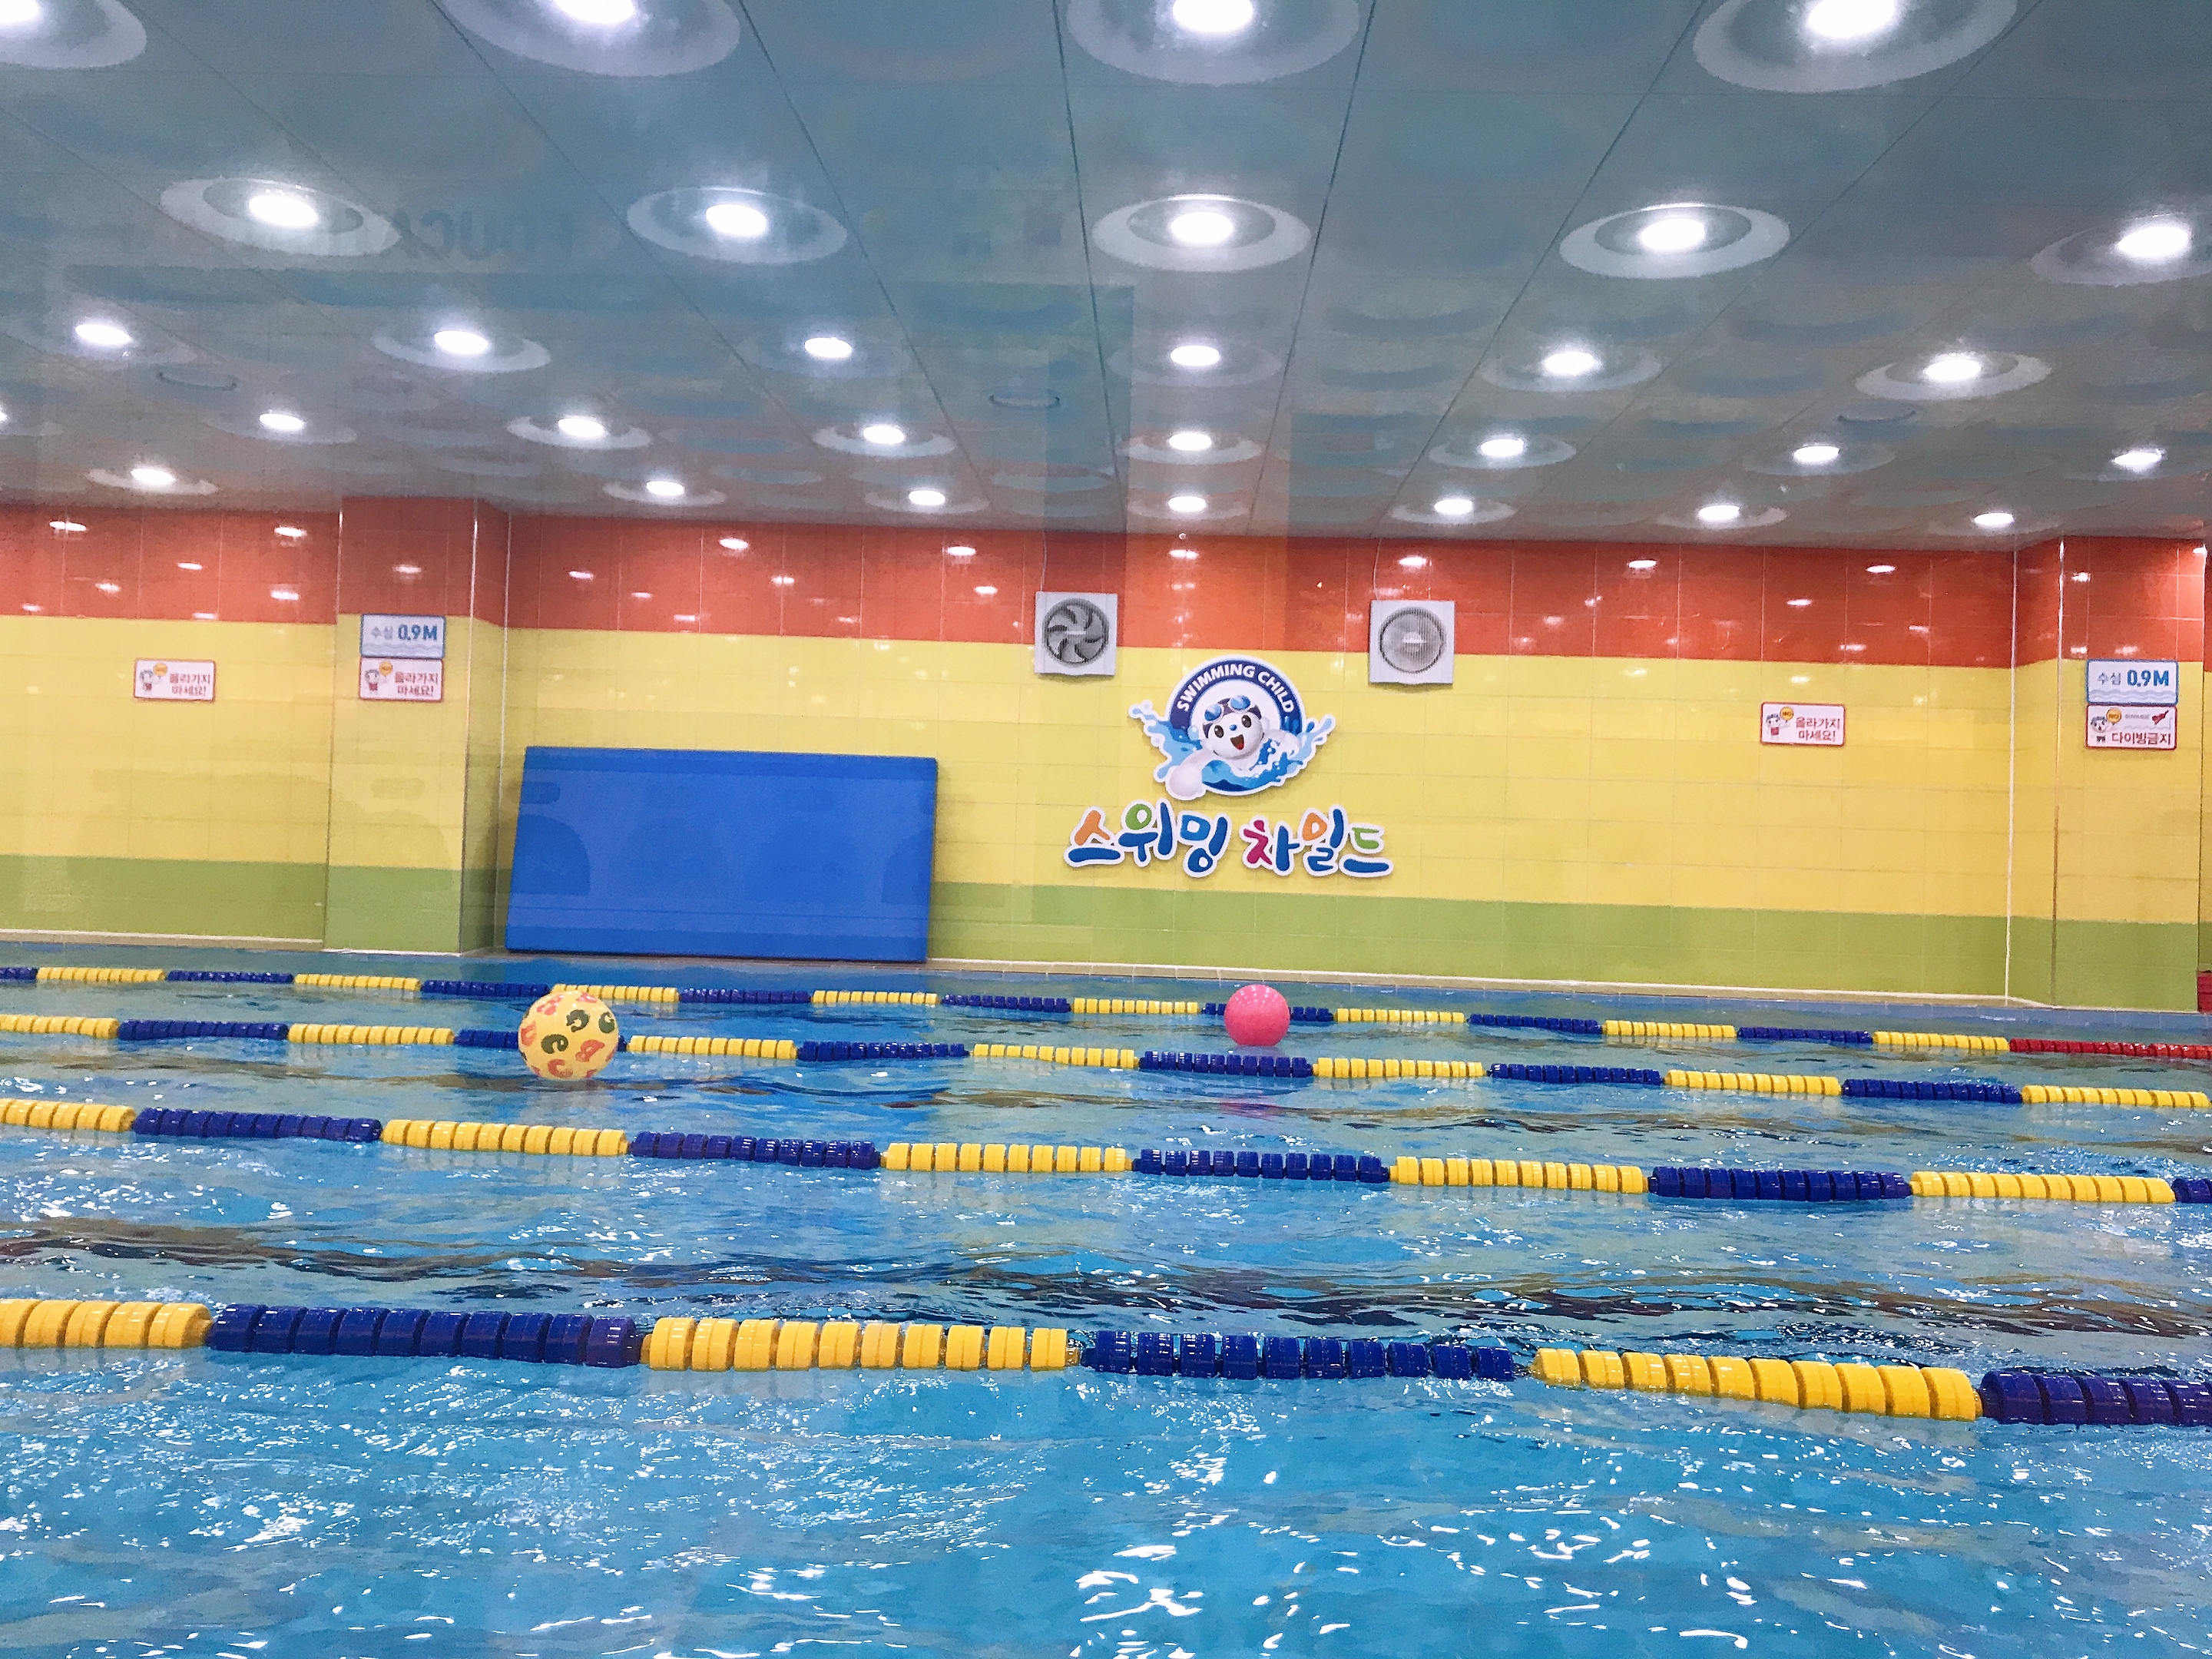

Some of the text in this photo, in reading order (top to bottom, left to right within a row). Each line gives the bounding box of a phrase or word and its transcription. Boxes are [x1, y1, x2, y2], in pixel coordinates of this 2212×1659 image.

[397, 624, 438, 641] 0.9M
[2097, 669, 2170, 687] 수심 0.9M
[1177, 662, 1296, 714] SWIMMING CHILD
[1798, 730, 1836, 742] 마세요!
[2111, 731, 2172, 746] 다이빙금지
[1067, 801, 1391, 874] 스위밍 차일드
